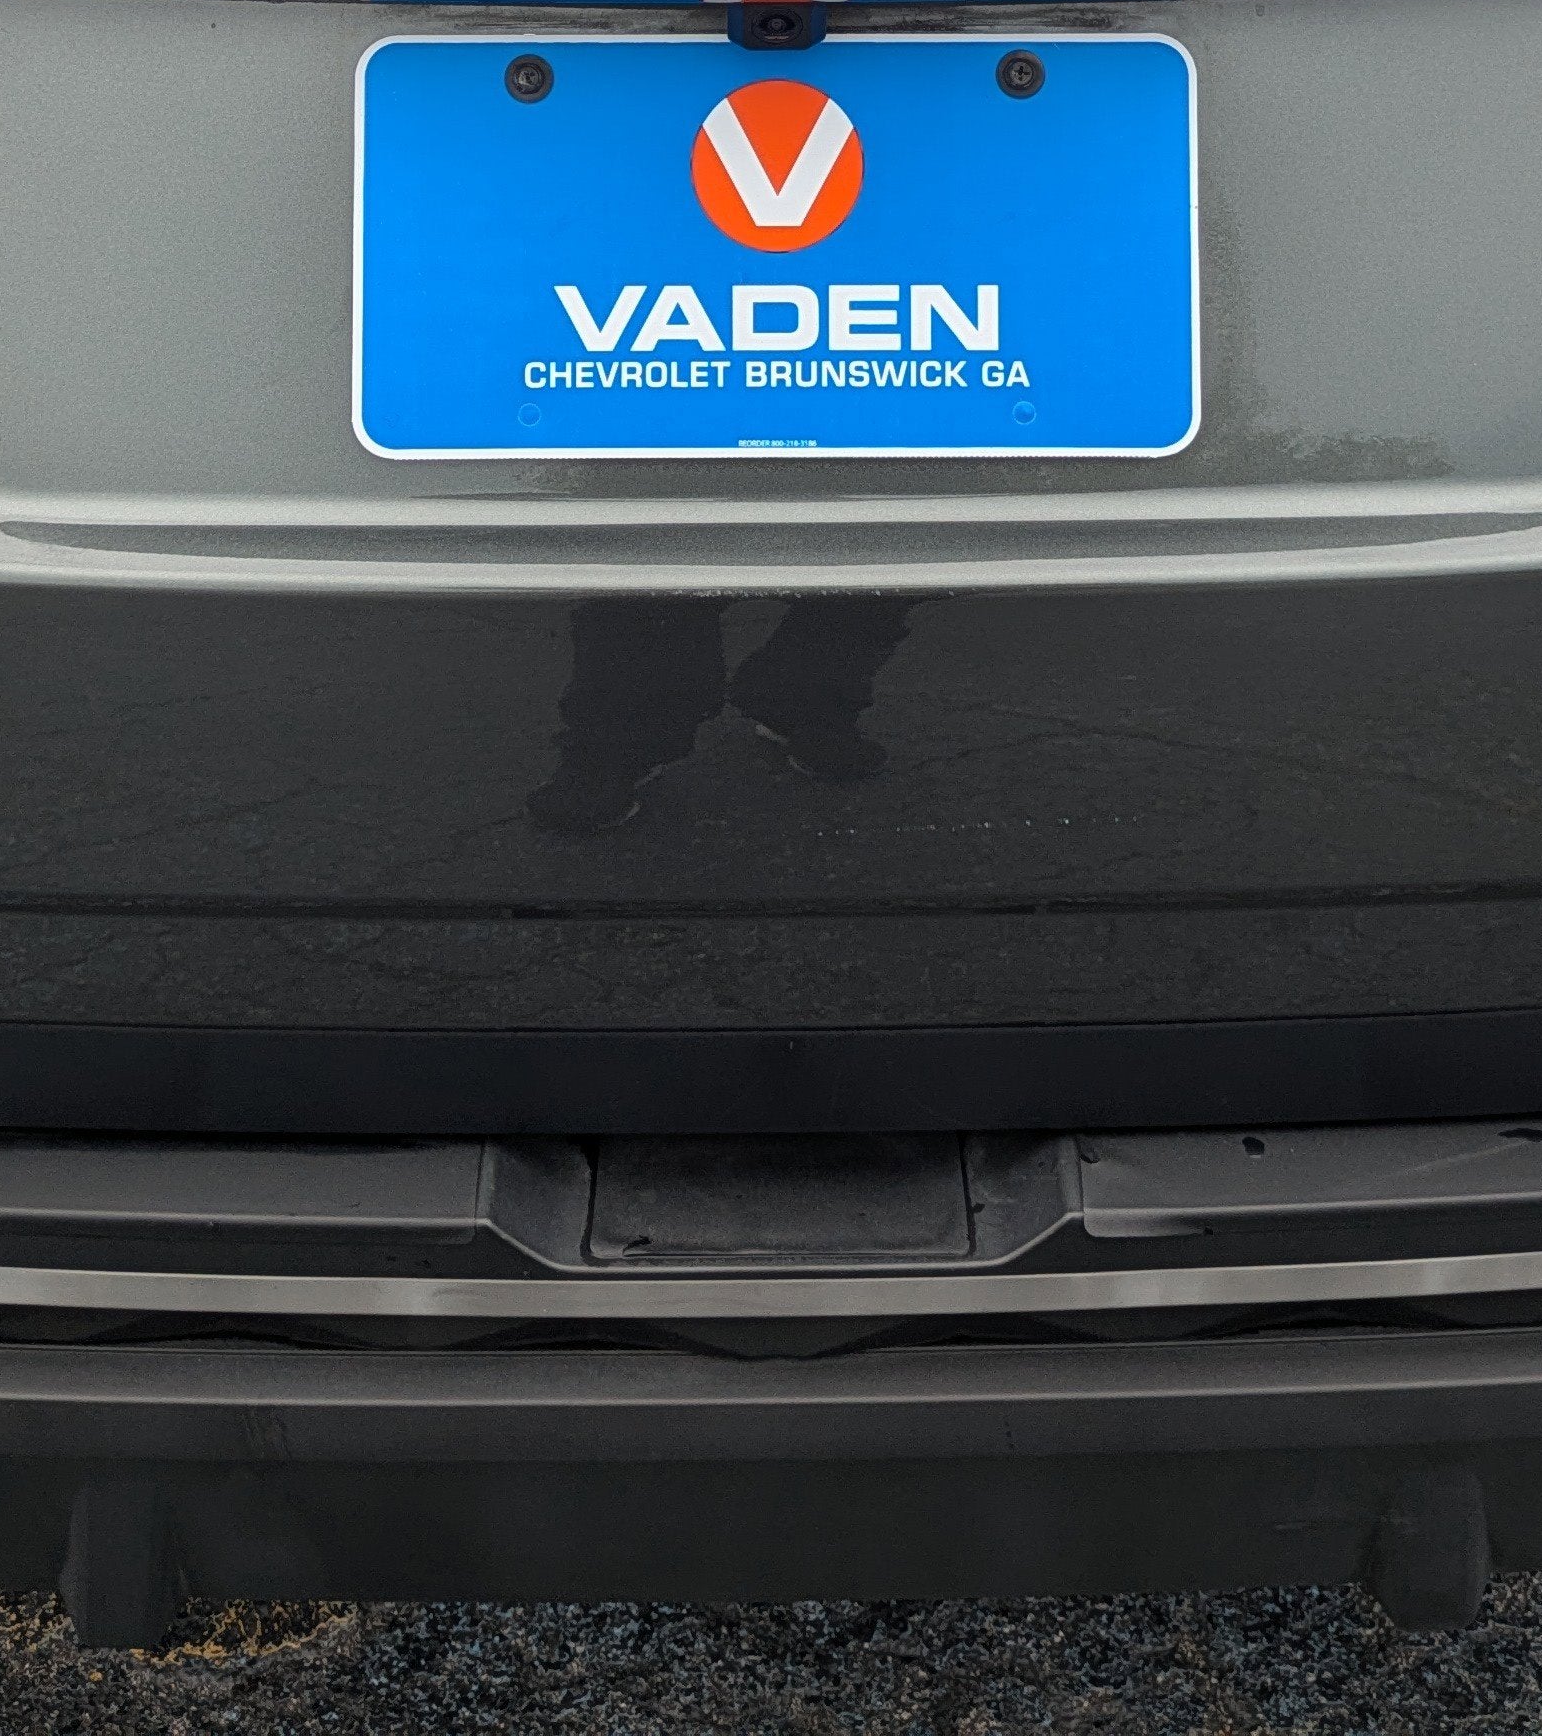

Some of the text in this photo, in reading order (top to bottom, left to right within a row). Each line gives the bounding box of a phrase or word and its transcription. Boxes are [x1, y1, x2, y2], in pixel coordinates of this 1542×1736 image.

[554, 284, 999, 352] VADEN
[524, 360, 1031, 389] CHEVROLET BRUNSWICK GA
